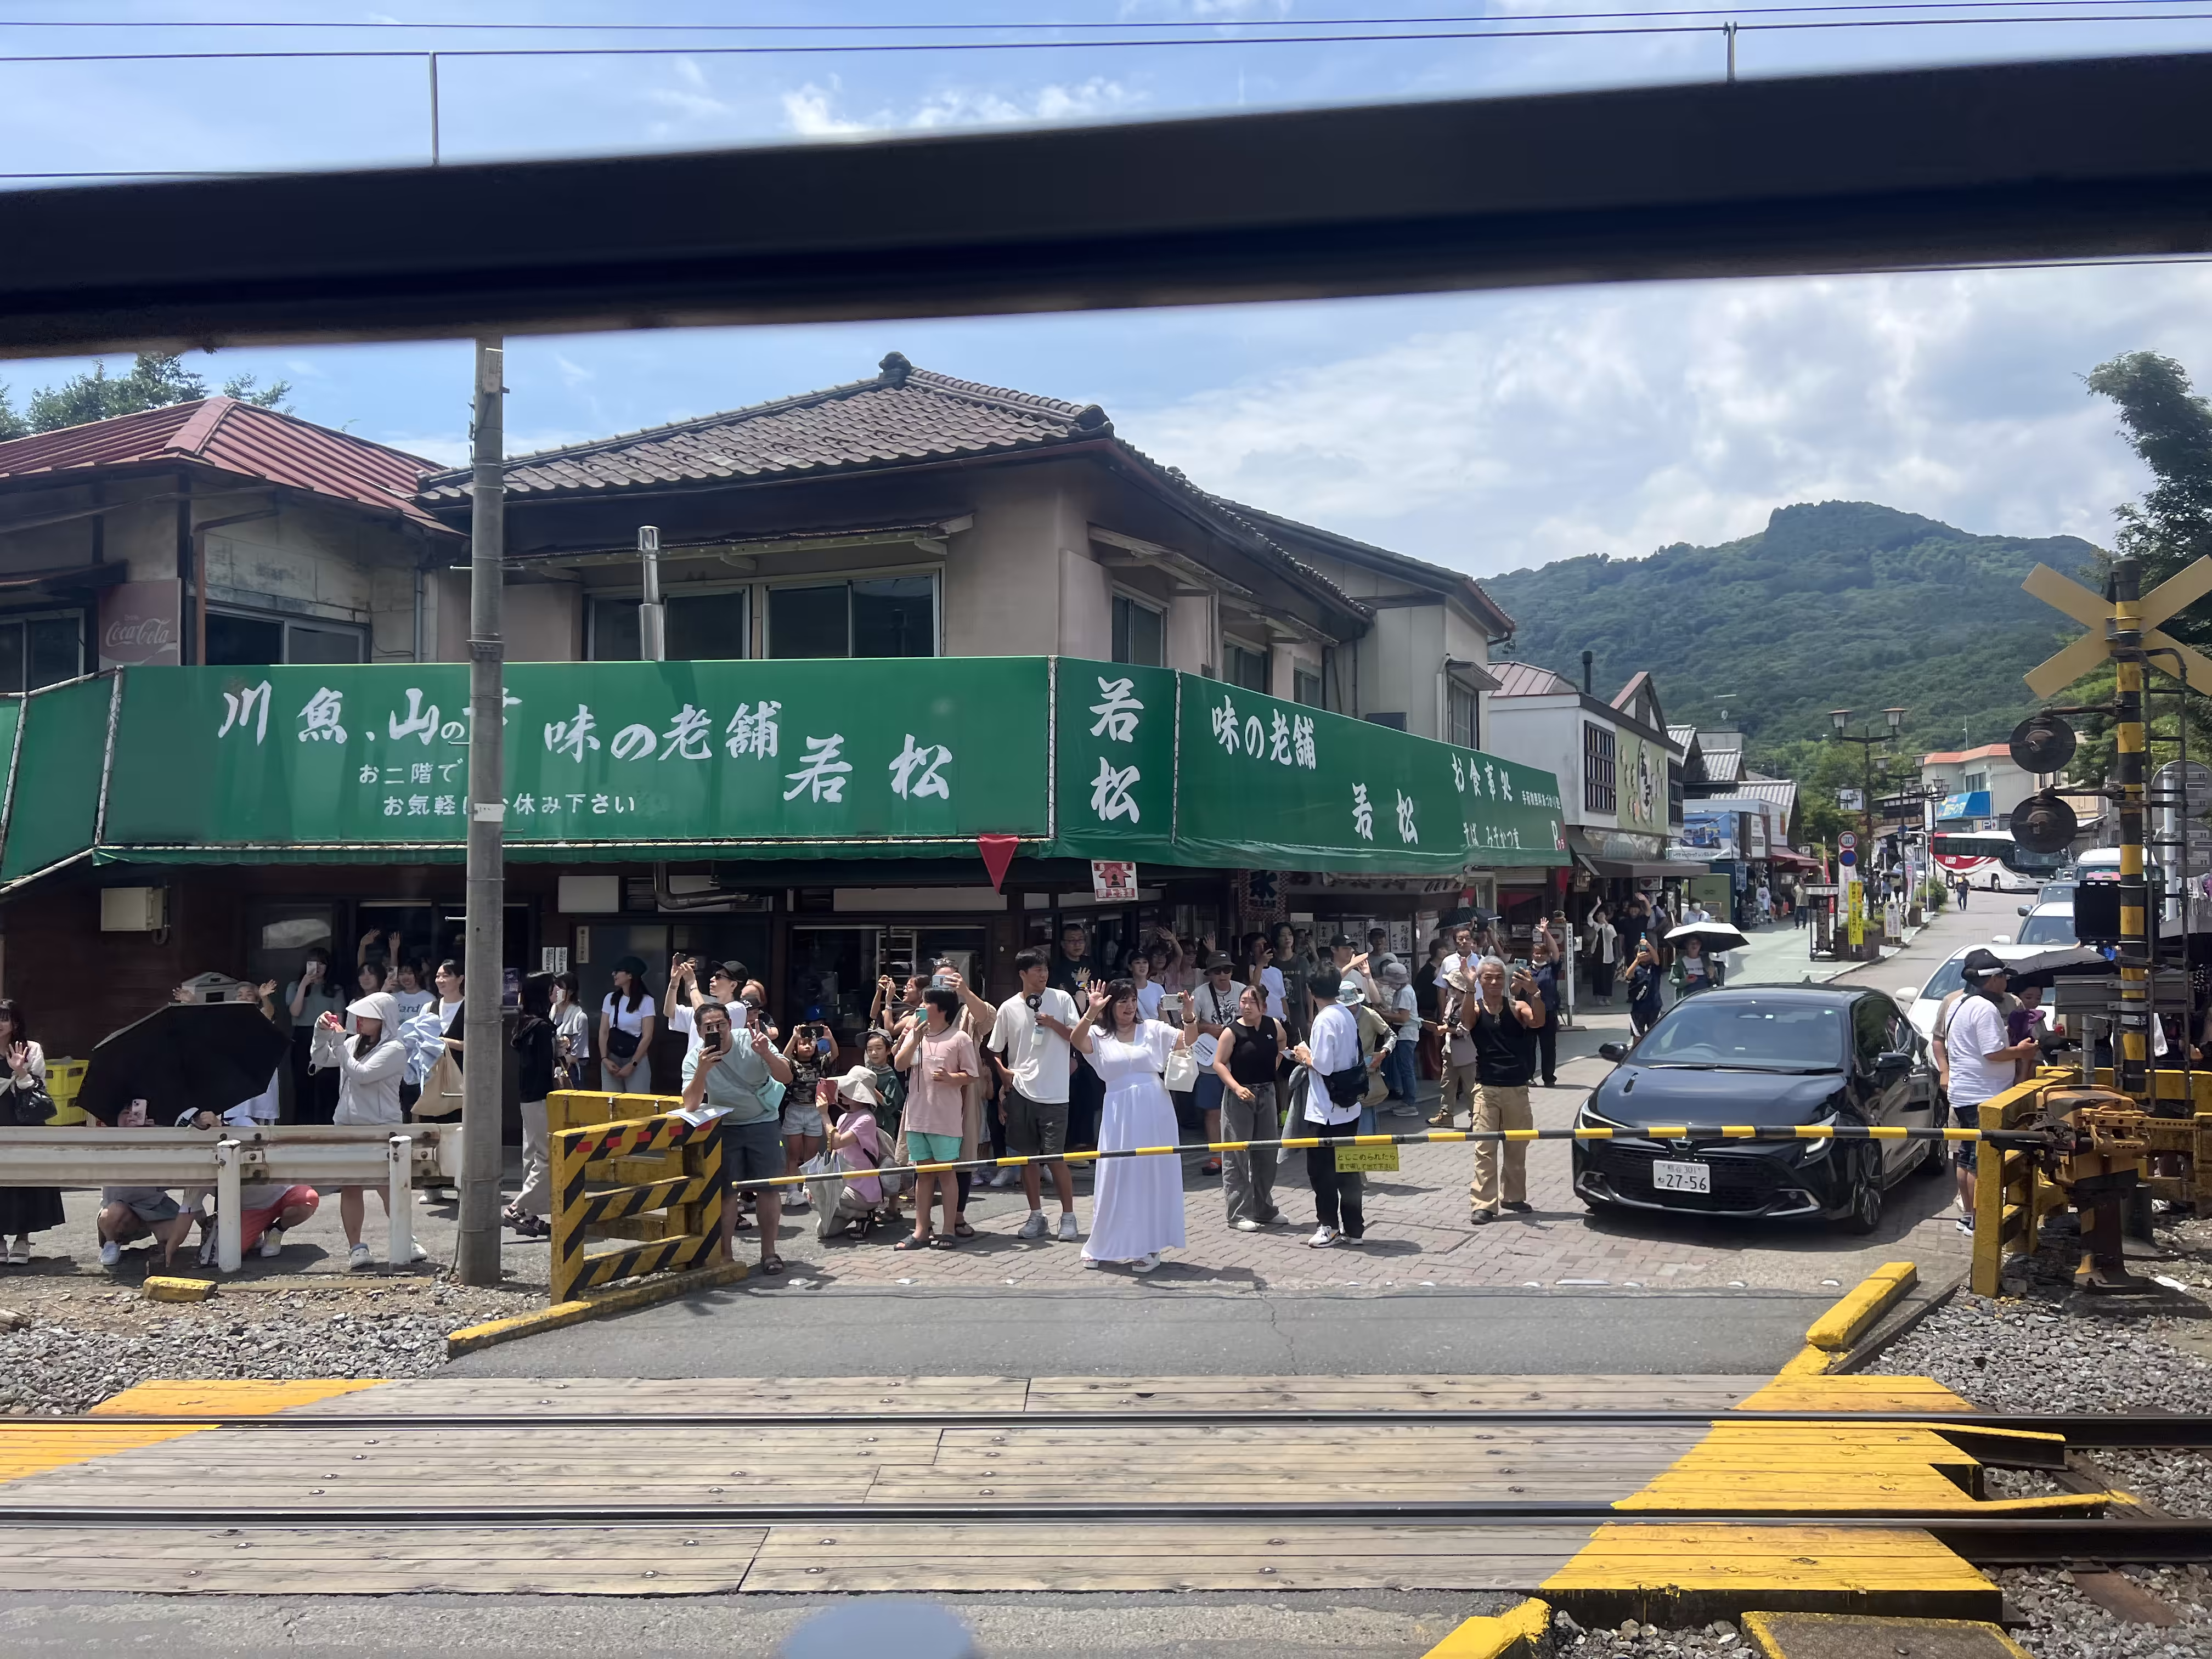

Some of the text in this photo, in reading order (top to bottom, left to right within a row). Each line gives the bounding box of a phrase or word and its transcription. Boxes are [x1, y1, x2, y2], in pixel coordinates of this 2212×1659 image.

[105, 618, 171, 647] Coca-Cola
[544, 701, 782, 763] 味の老舗
[783, 733, 953, 803] 若松
[1089, 676, 1144, 823] 若松
[1211, 695, 1316, 770] 味の老舗
[359, 758, 464, 784] お二階で
[1452, 752, 1513, 802] お食事処
[1352, 782, 1418, 845] 若松
[1666, 1174, 1706, 1190] 27-56
